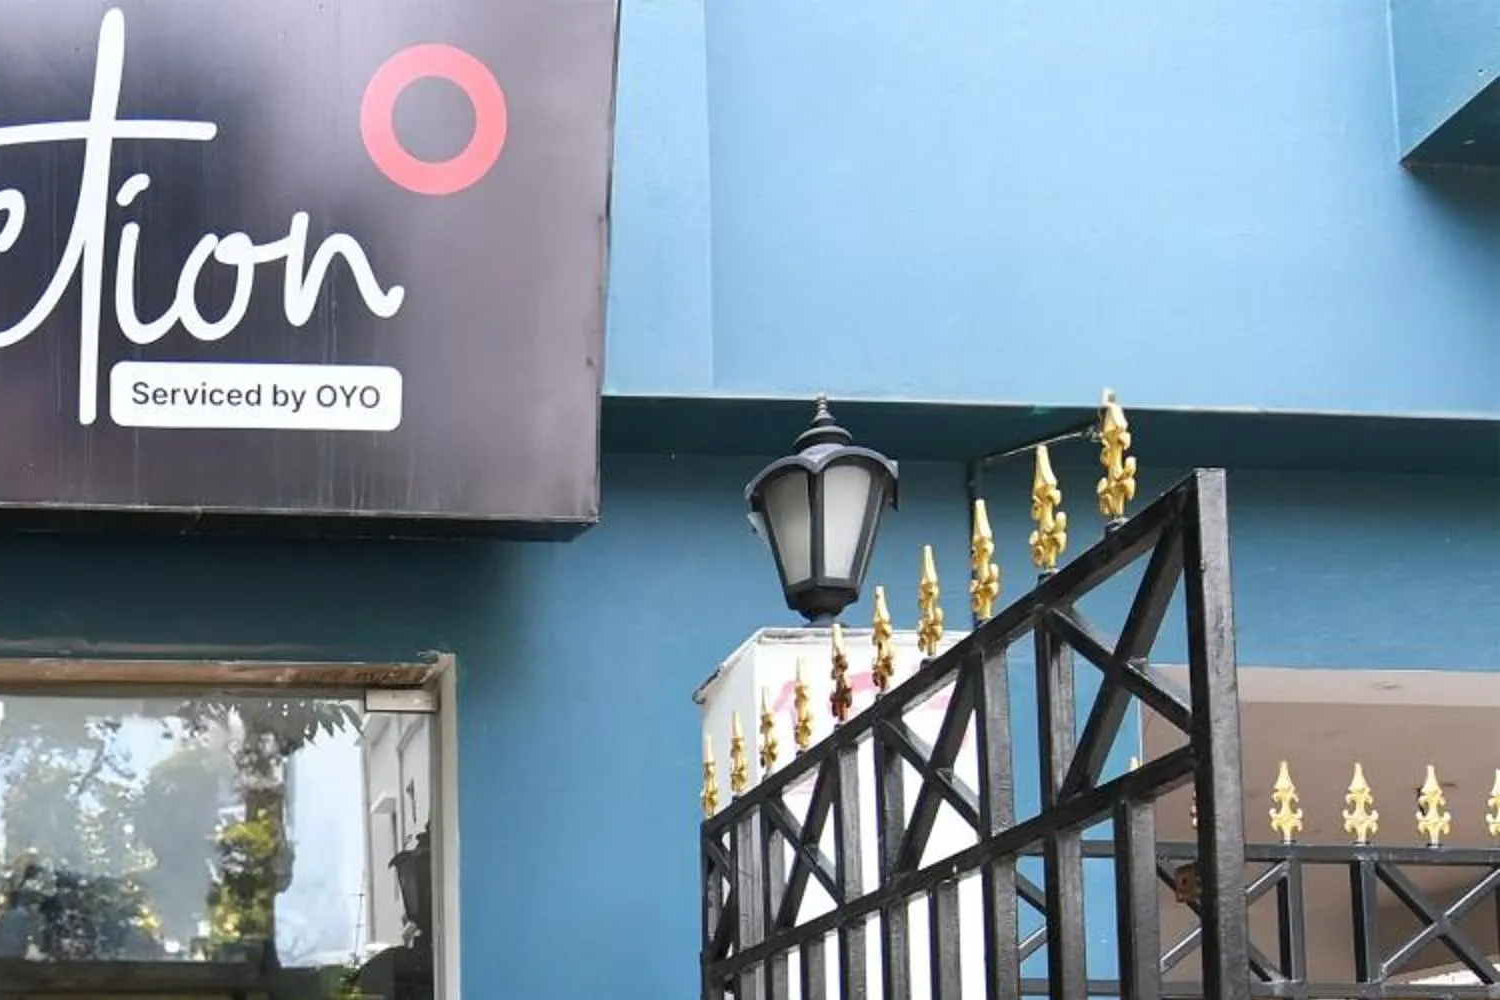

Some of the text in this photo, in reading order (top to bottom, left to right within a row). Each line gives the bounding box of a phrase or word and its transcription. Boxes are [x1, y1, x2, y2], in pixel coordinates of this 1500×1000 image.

[132, 381, 381, 413] Serviced by OYO
